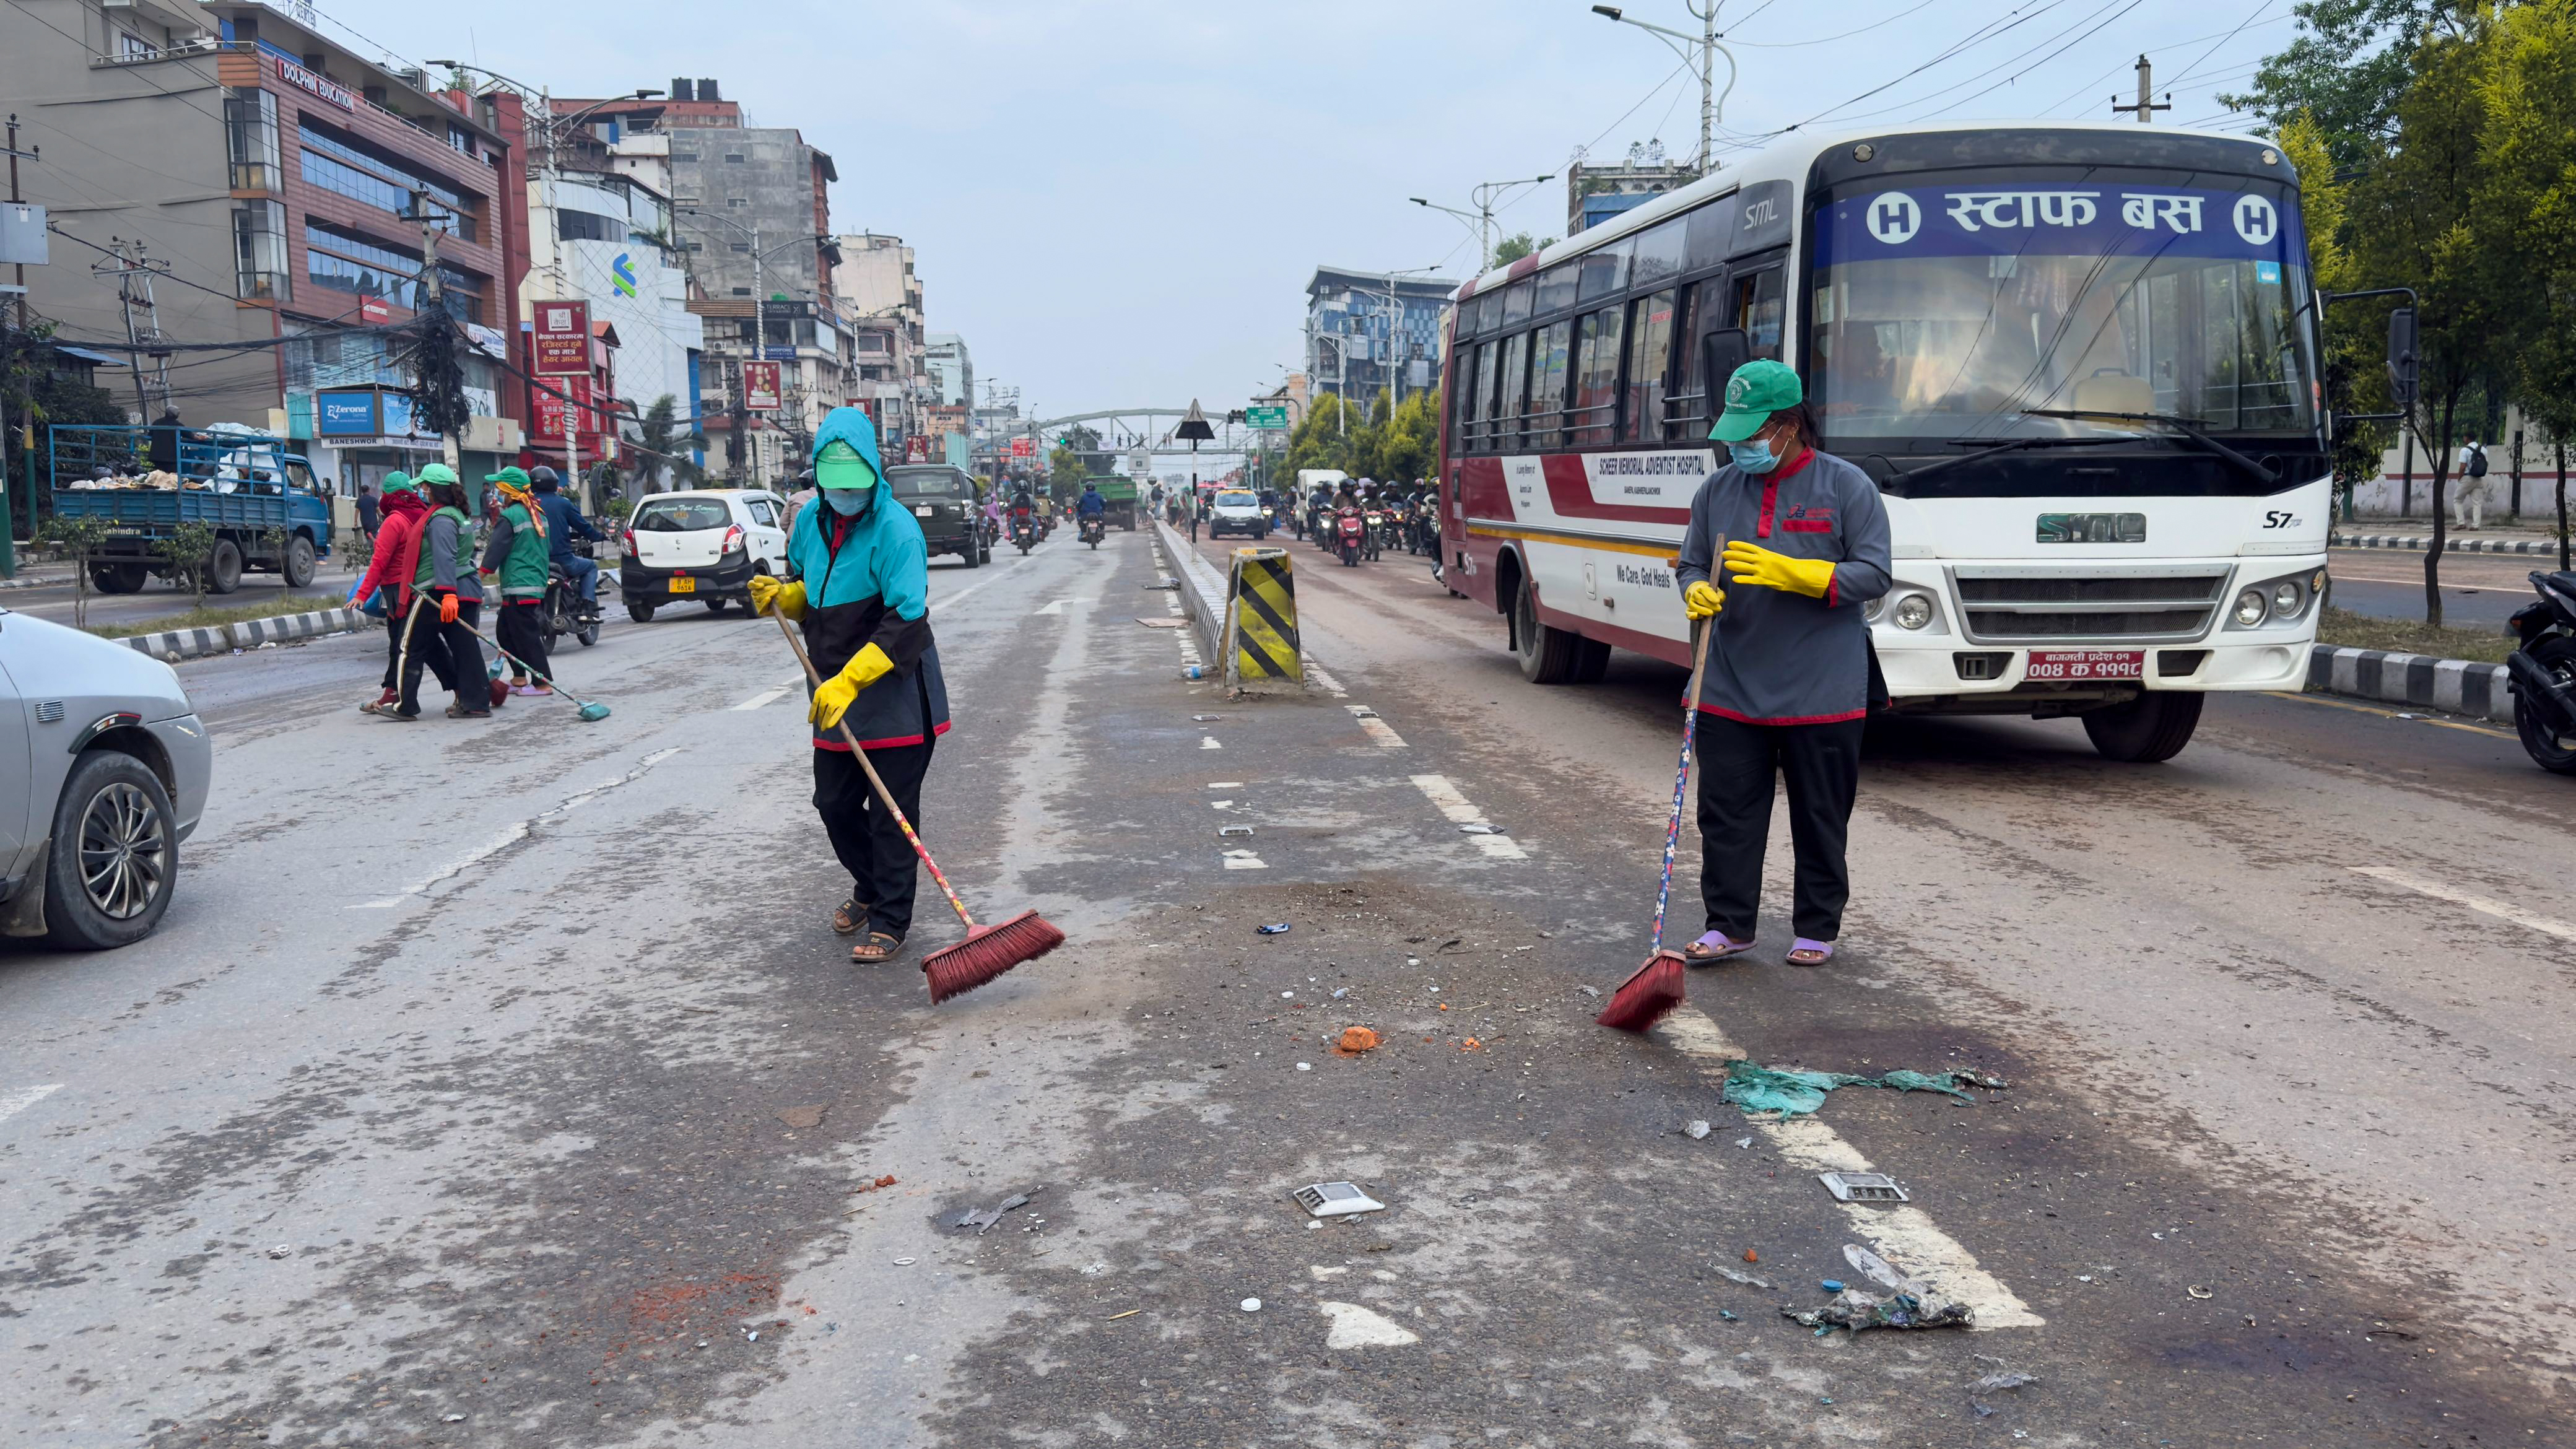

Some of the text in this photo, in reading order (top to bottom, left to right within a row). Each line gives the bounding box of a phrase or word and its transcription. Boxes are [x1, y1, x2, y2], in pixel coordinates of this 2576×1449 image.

[284, 63, 354, 110] DOLPHIN EDUCATION
[1744, 198, 1778, 230] SML
[1945, 191, 2205, 234] स्टाफ बस
[1599, 455, 1705, 476] SCHEER MEMORIAL ADVENTIST HOSPITAL
[2037, 513, 2144, 541] SML
[1617, 565, 1670, 588] We Care, God Heals
[2045, 652, 2085, 661] बागमती
[2071, 663, 2091, 676] क
[2095, 663, 2141, 676] १११८
